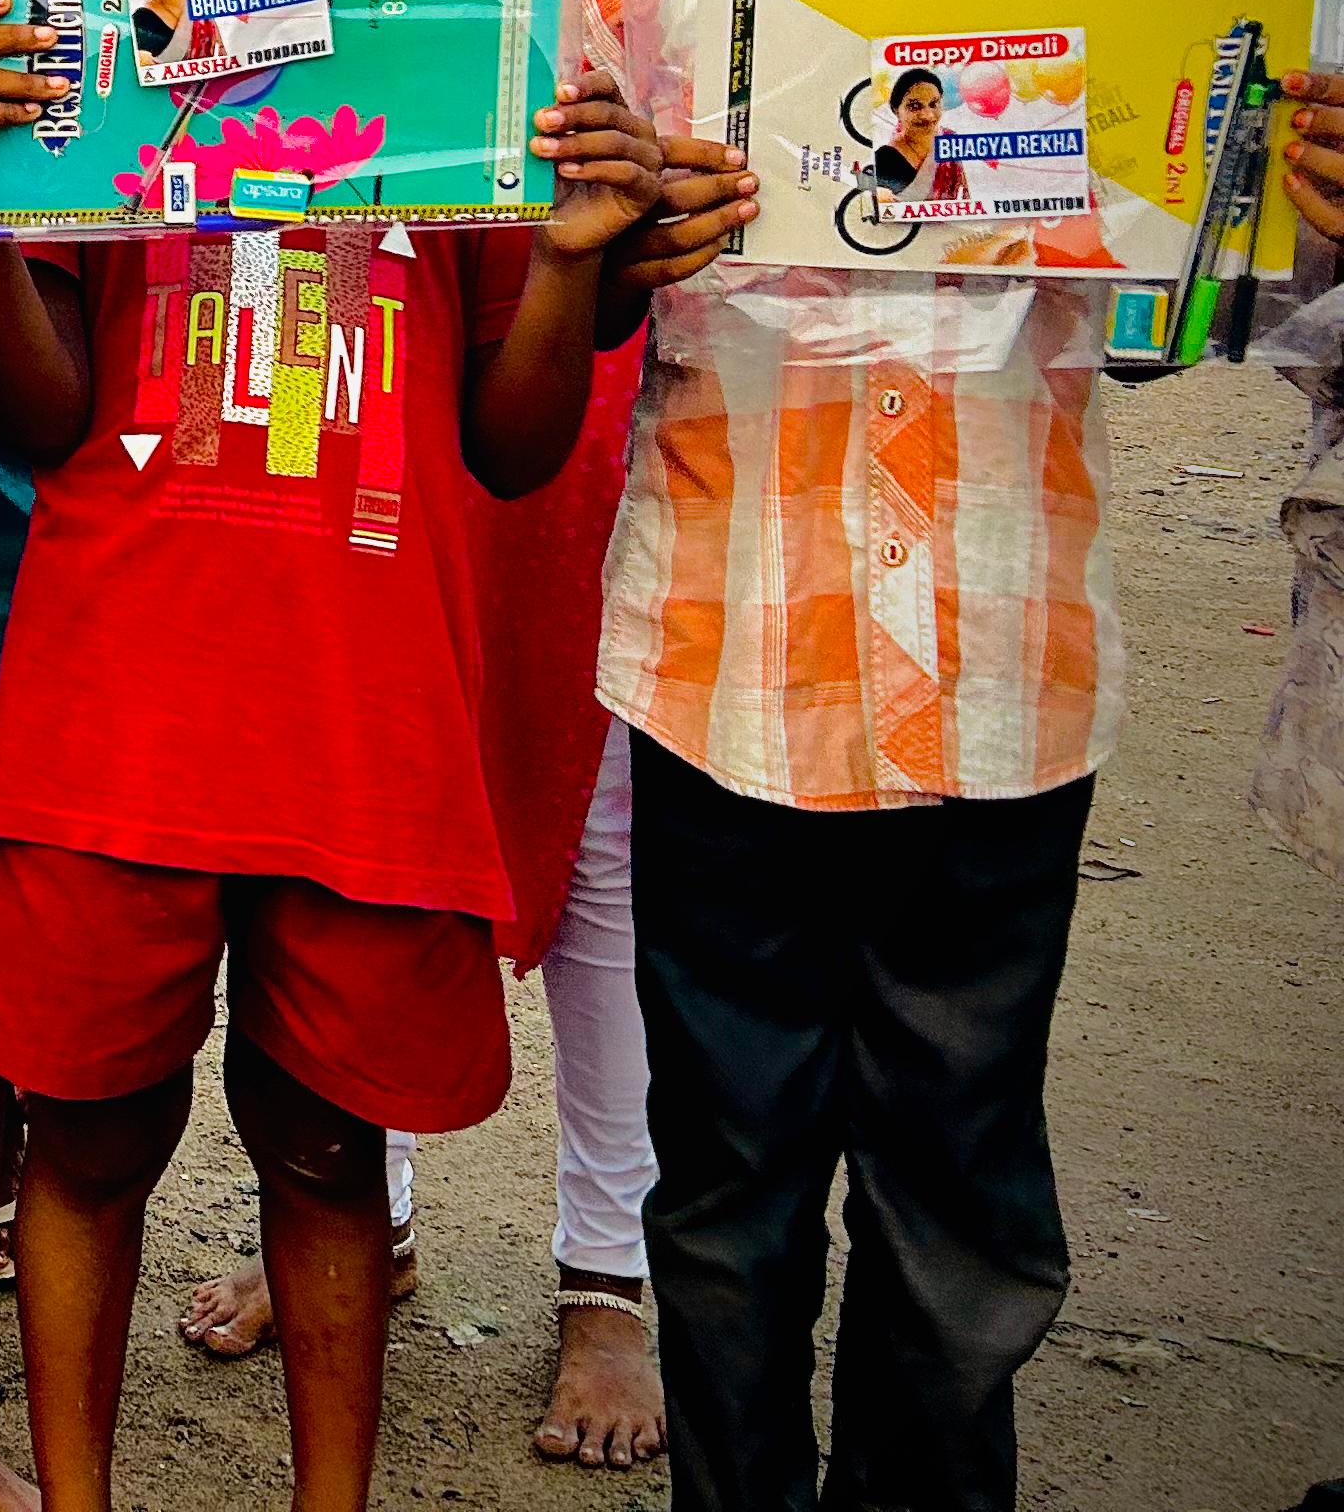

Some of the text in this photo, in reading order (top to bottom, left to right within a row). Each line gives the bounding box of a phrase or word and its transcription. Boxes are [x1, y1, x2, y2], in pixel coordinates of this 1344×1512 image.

[99, 31, 115, 89] ORIGINAL
[894, 36, 1059, 67] Happy Diwali
[162, 56, 242, 80] AARSHA
[939, 132, 1079, 159] BHAGYA REKHA
[902, 197, 1084, 219] AARSHA FOUNDATION
[146, 267, 404, 424] TALENT
